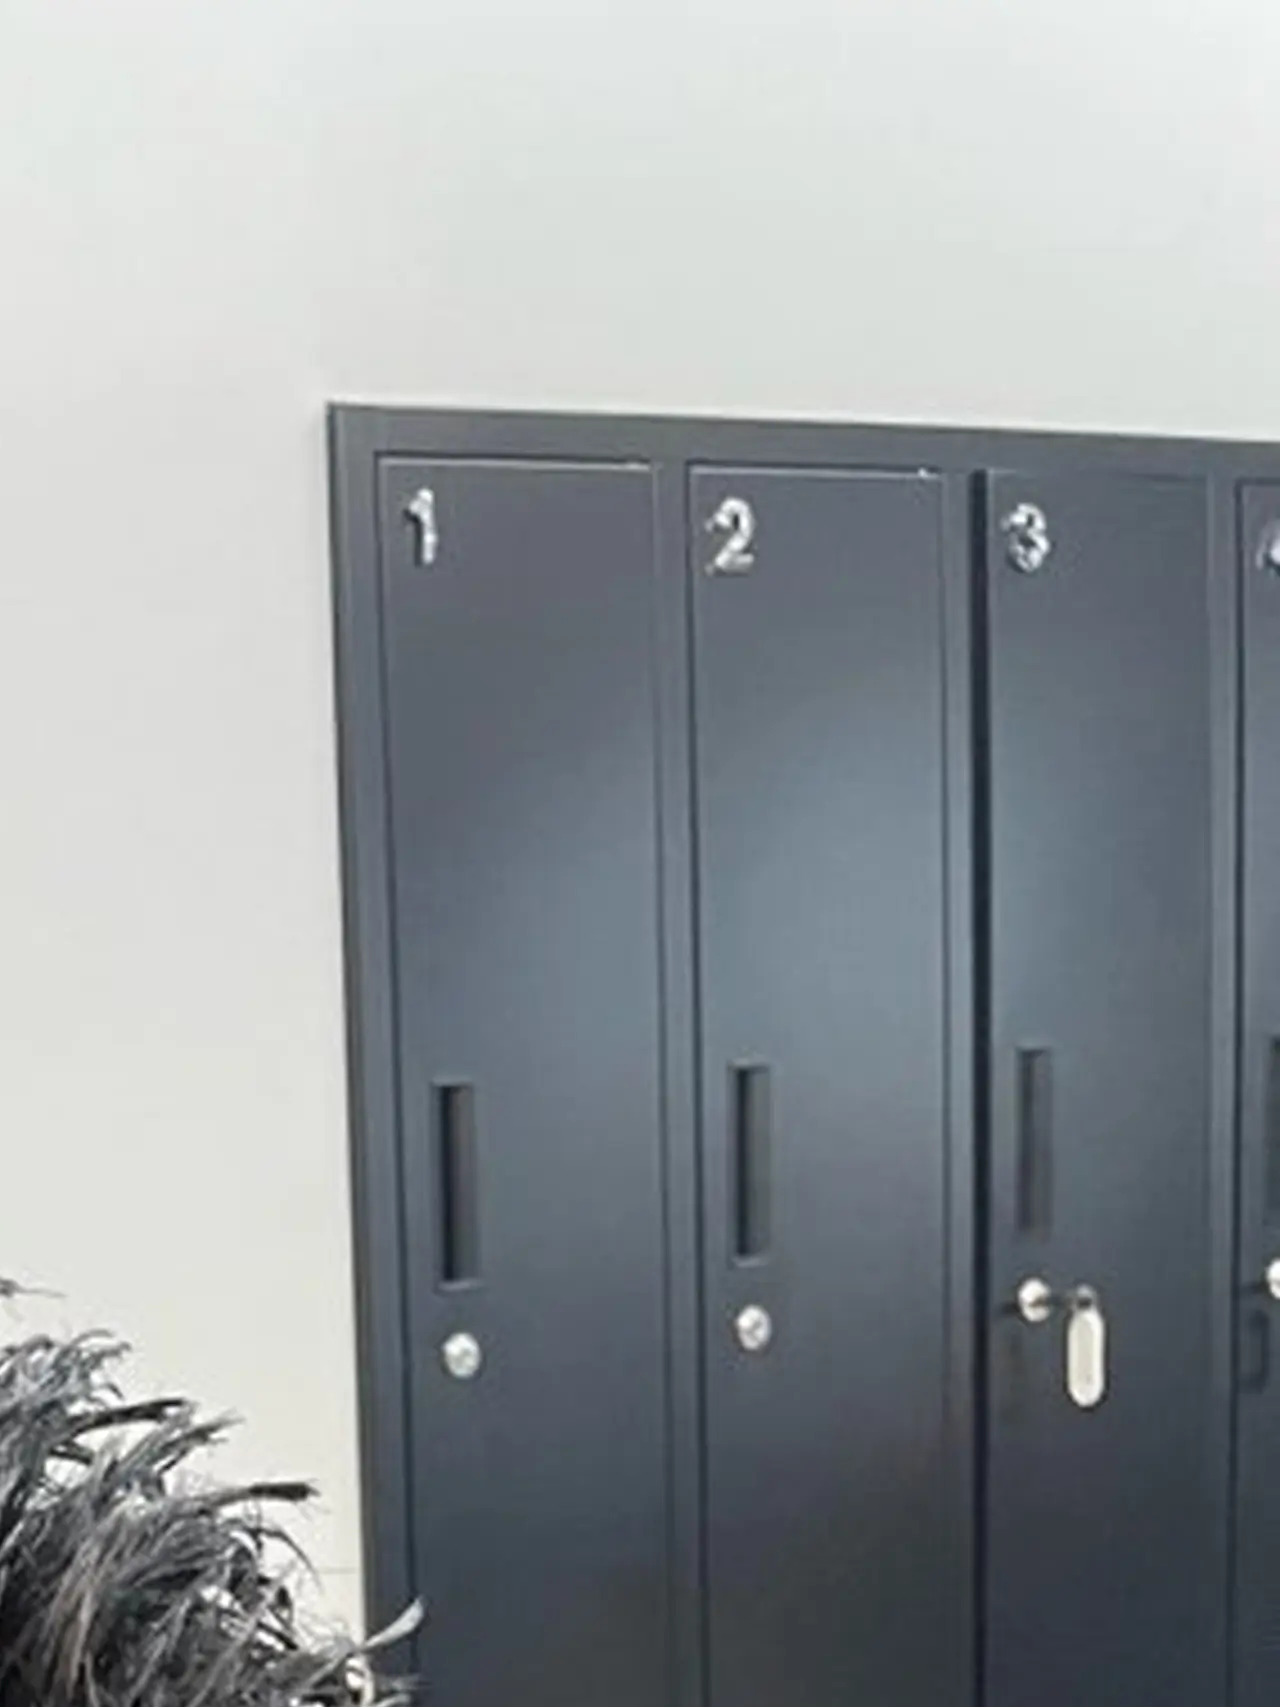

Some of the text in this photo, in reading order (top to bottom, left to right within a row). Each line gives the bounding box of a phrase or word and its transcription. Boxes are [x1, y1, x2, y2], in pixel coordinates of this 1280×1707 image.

[407, 487, 438, 565] 1
[705, 496, 755, 573] 2
[1002, 501, 1051, 572] 3
